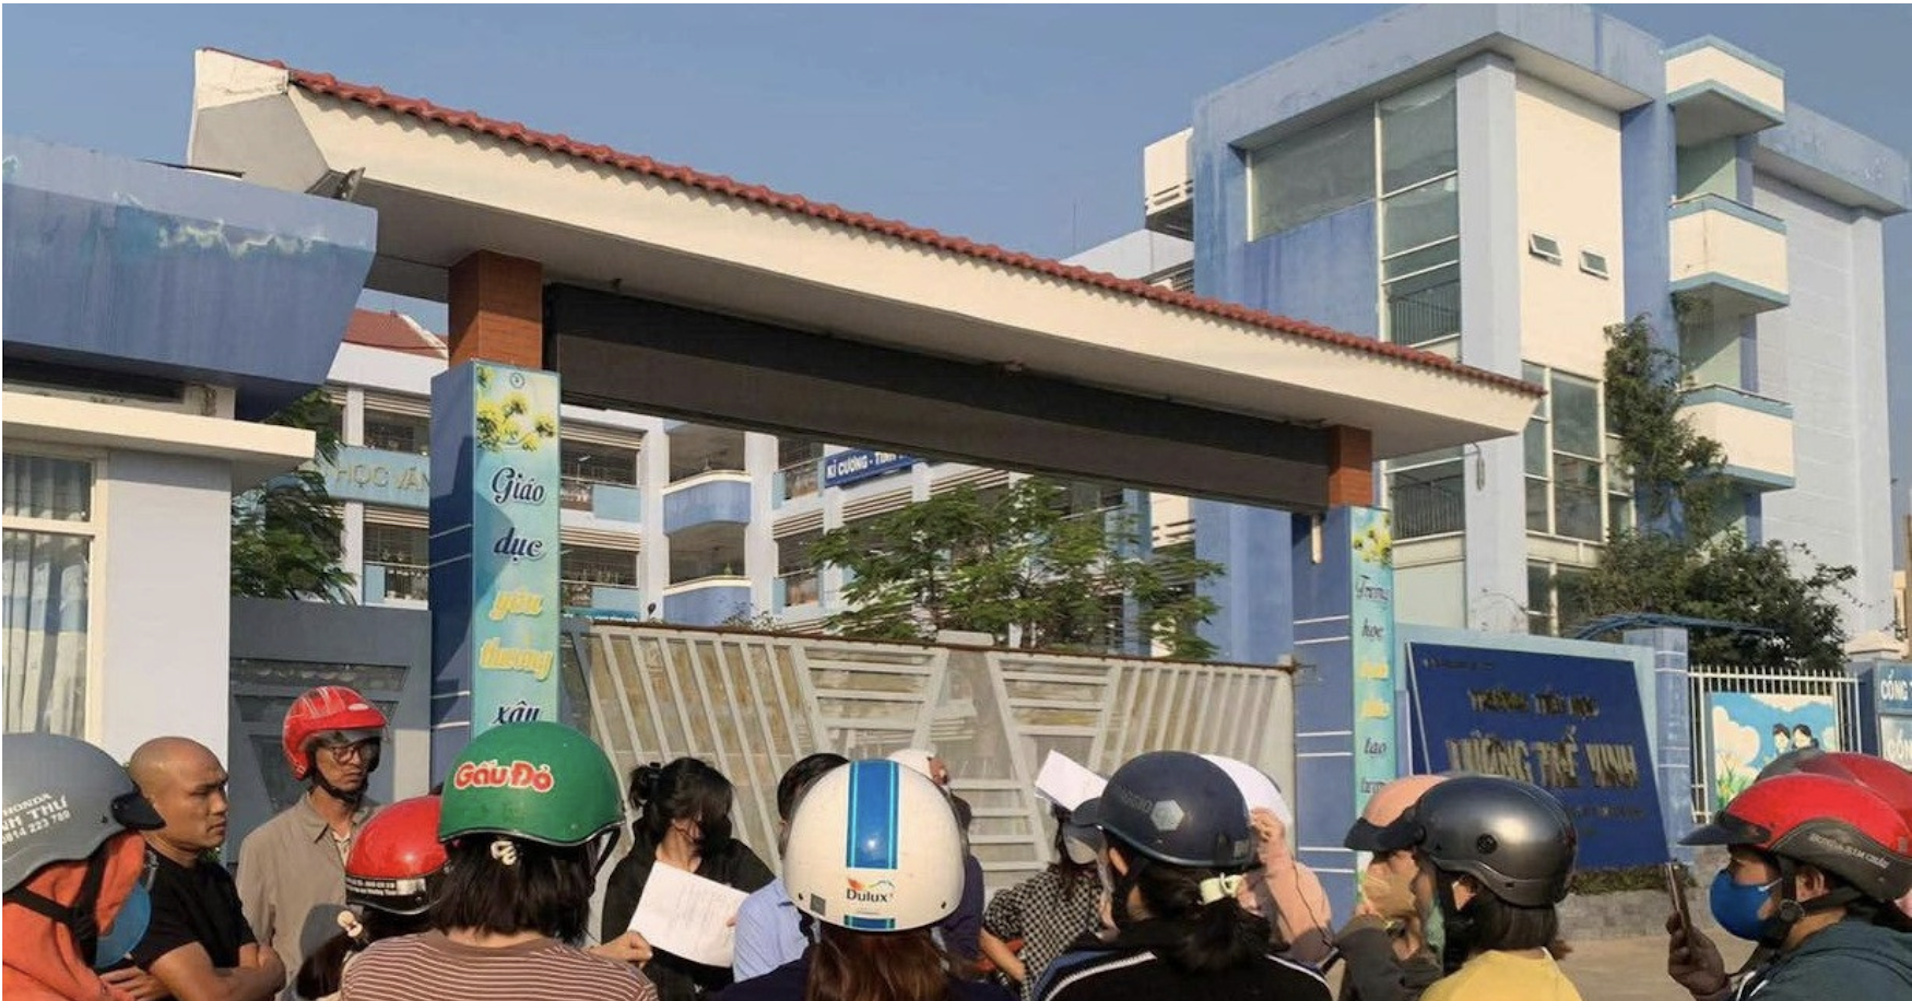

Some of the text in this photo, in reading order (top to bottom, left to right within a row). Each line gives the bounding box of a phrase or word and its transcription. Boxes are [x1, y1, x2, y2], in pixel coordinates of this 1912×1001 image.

[492, 467, 545, 504] Giáo
[494, 527, 543, 562] dục
[846, 888, 888, 902] Dulux
